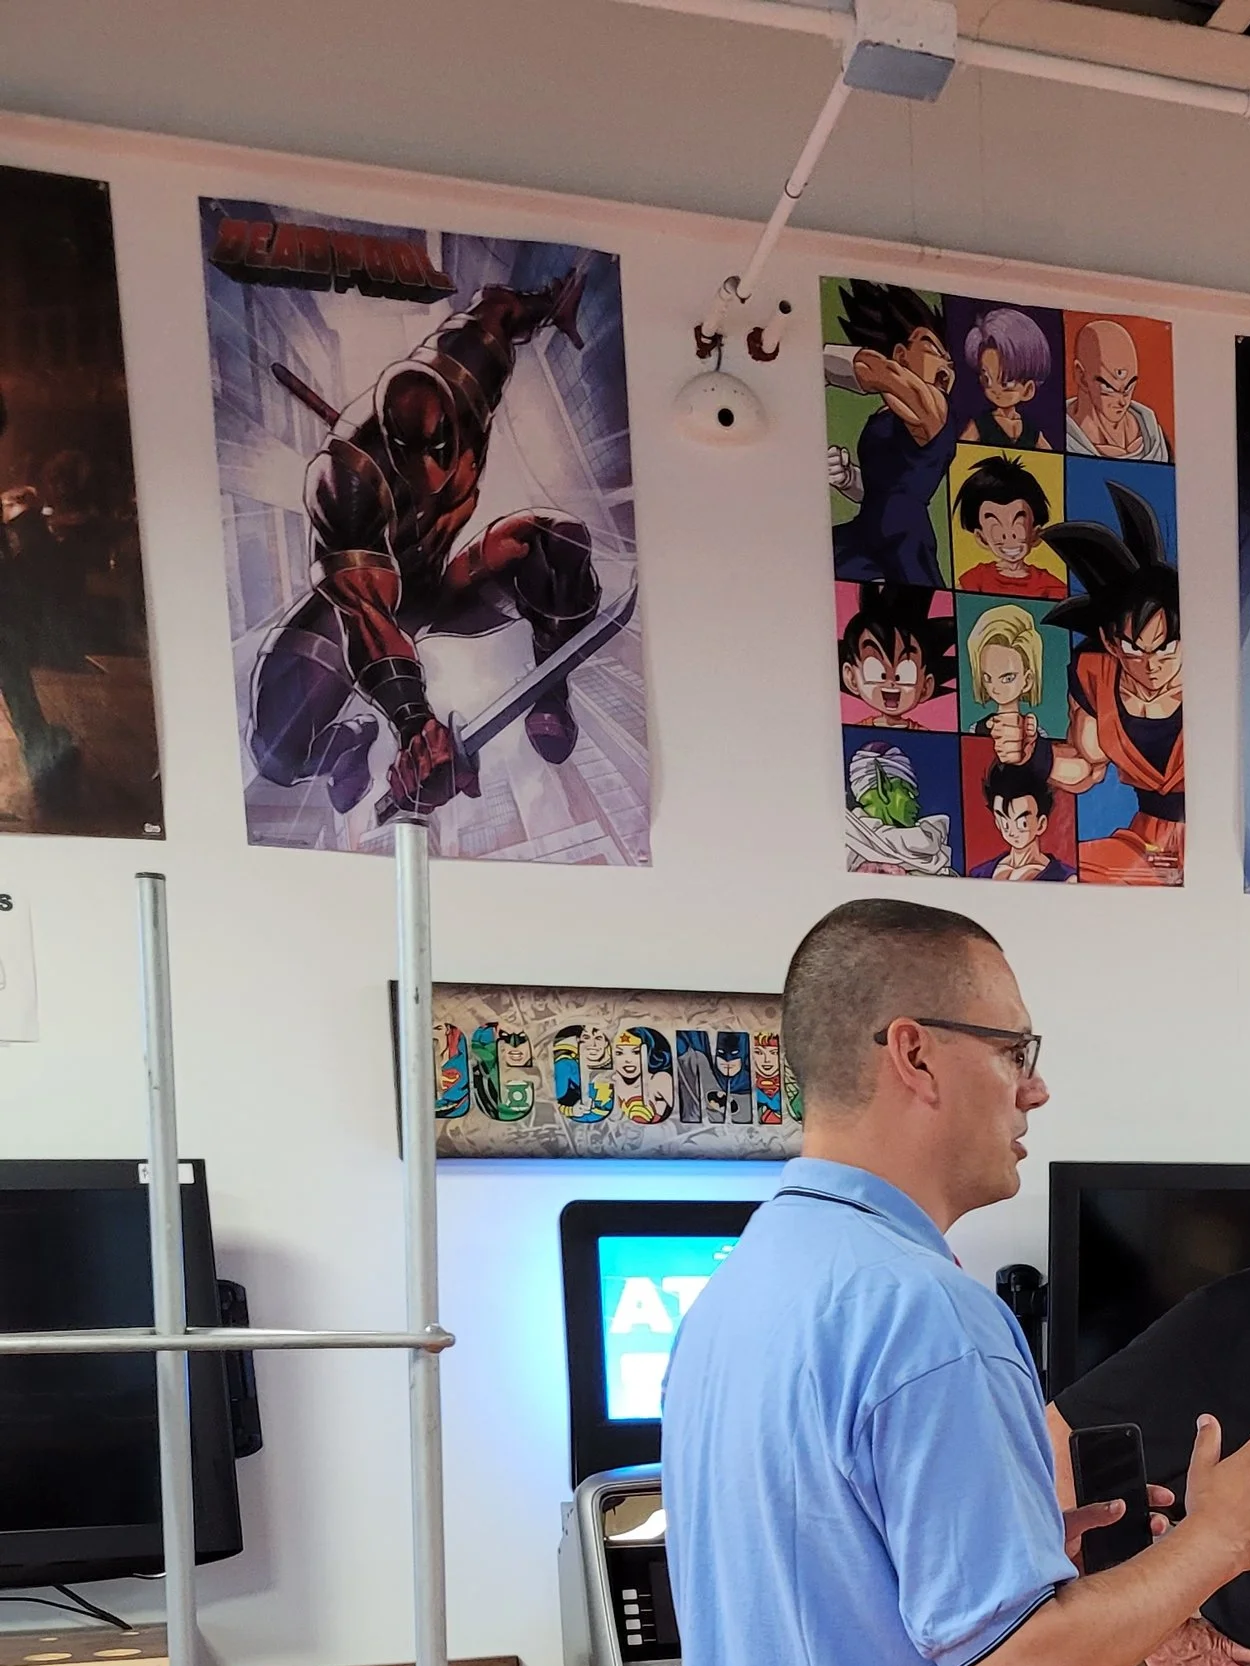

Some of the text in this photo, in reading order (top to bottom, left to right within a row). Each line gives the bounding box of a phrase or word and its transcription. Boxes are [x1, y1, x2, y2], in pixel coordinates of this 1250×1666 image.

[210, 217, 457, 300] DEADPOOL
[552, 1024, 804, 1125] COMI
[609, 1276, 712, 1334] AT
